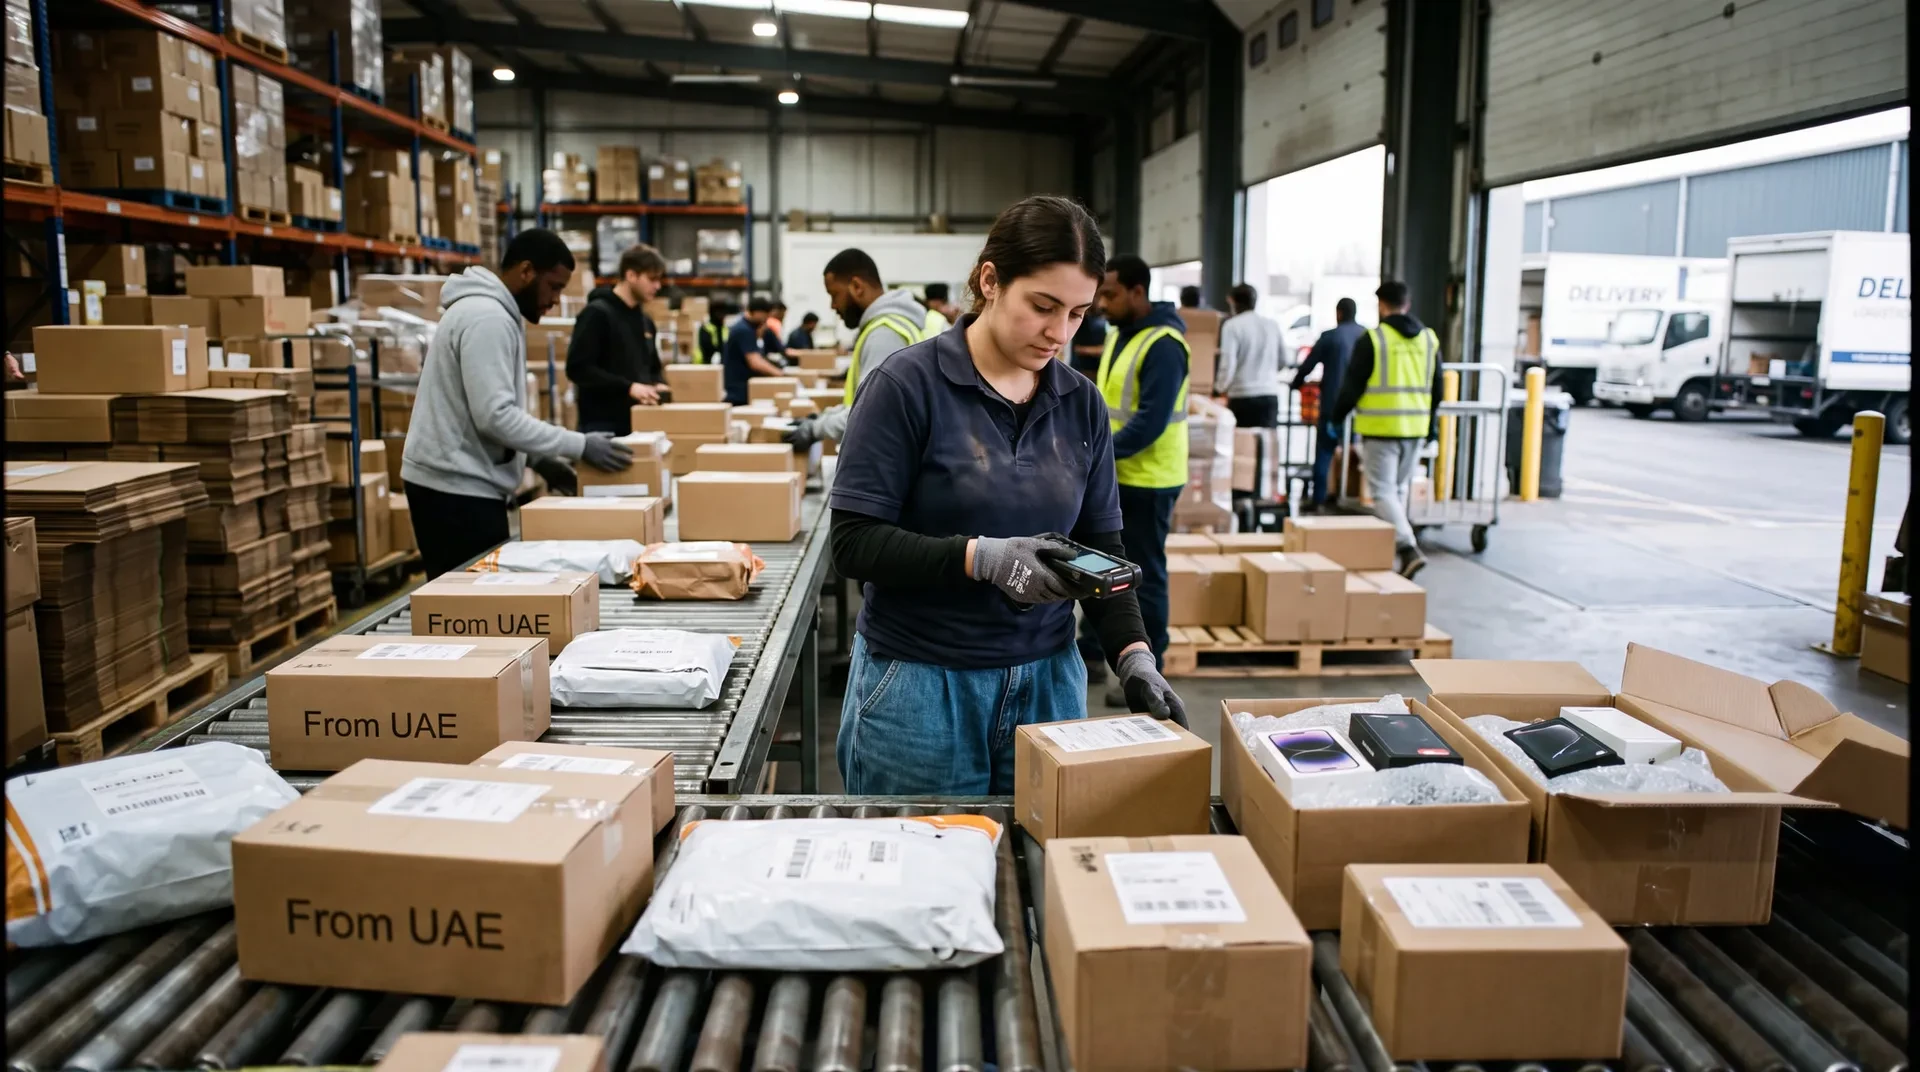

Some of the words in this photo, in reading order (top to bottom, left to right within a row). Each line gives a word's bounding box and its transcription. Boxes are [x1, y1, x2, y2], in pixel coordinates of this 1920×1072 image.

[1568, 285, 1666, 302] DELIVERY
[1858, 277, 1908, 299] DEL
[428, 613, 488, 635] From
[497, 613, 551, 635] UAE
[304, 710, 380, 738] From
[391, 712, 459, 739] UAE
[286, 897, 394, 943] From
[408, 906, 505, 951] UAE
